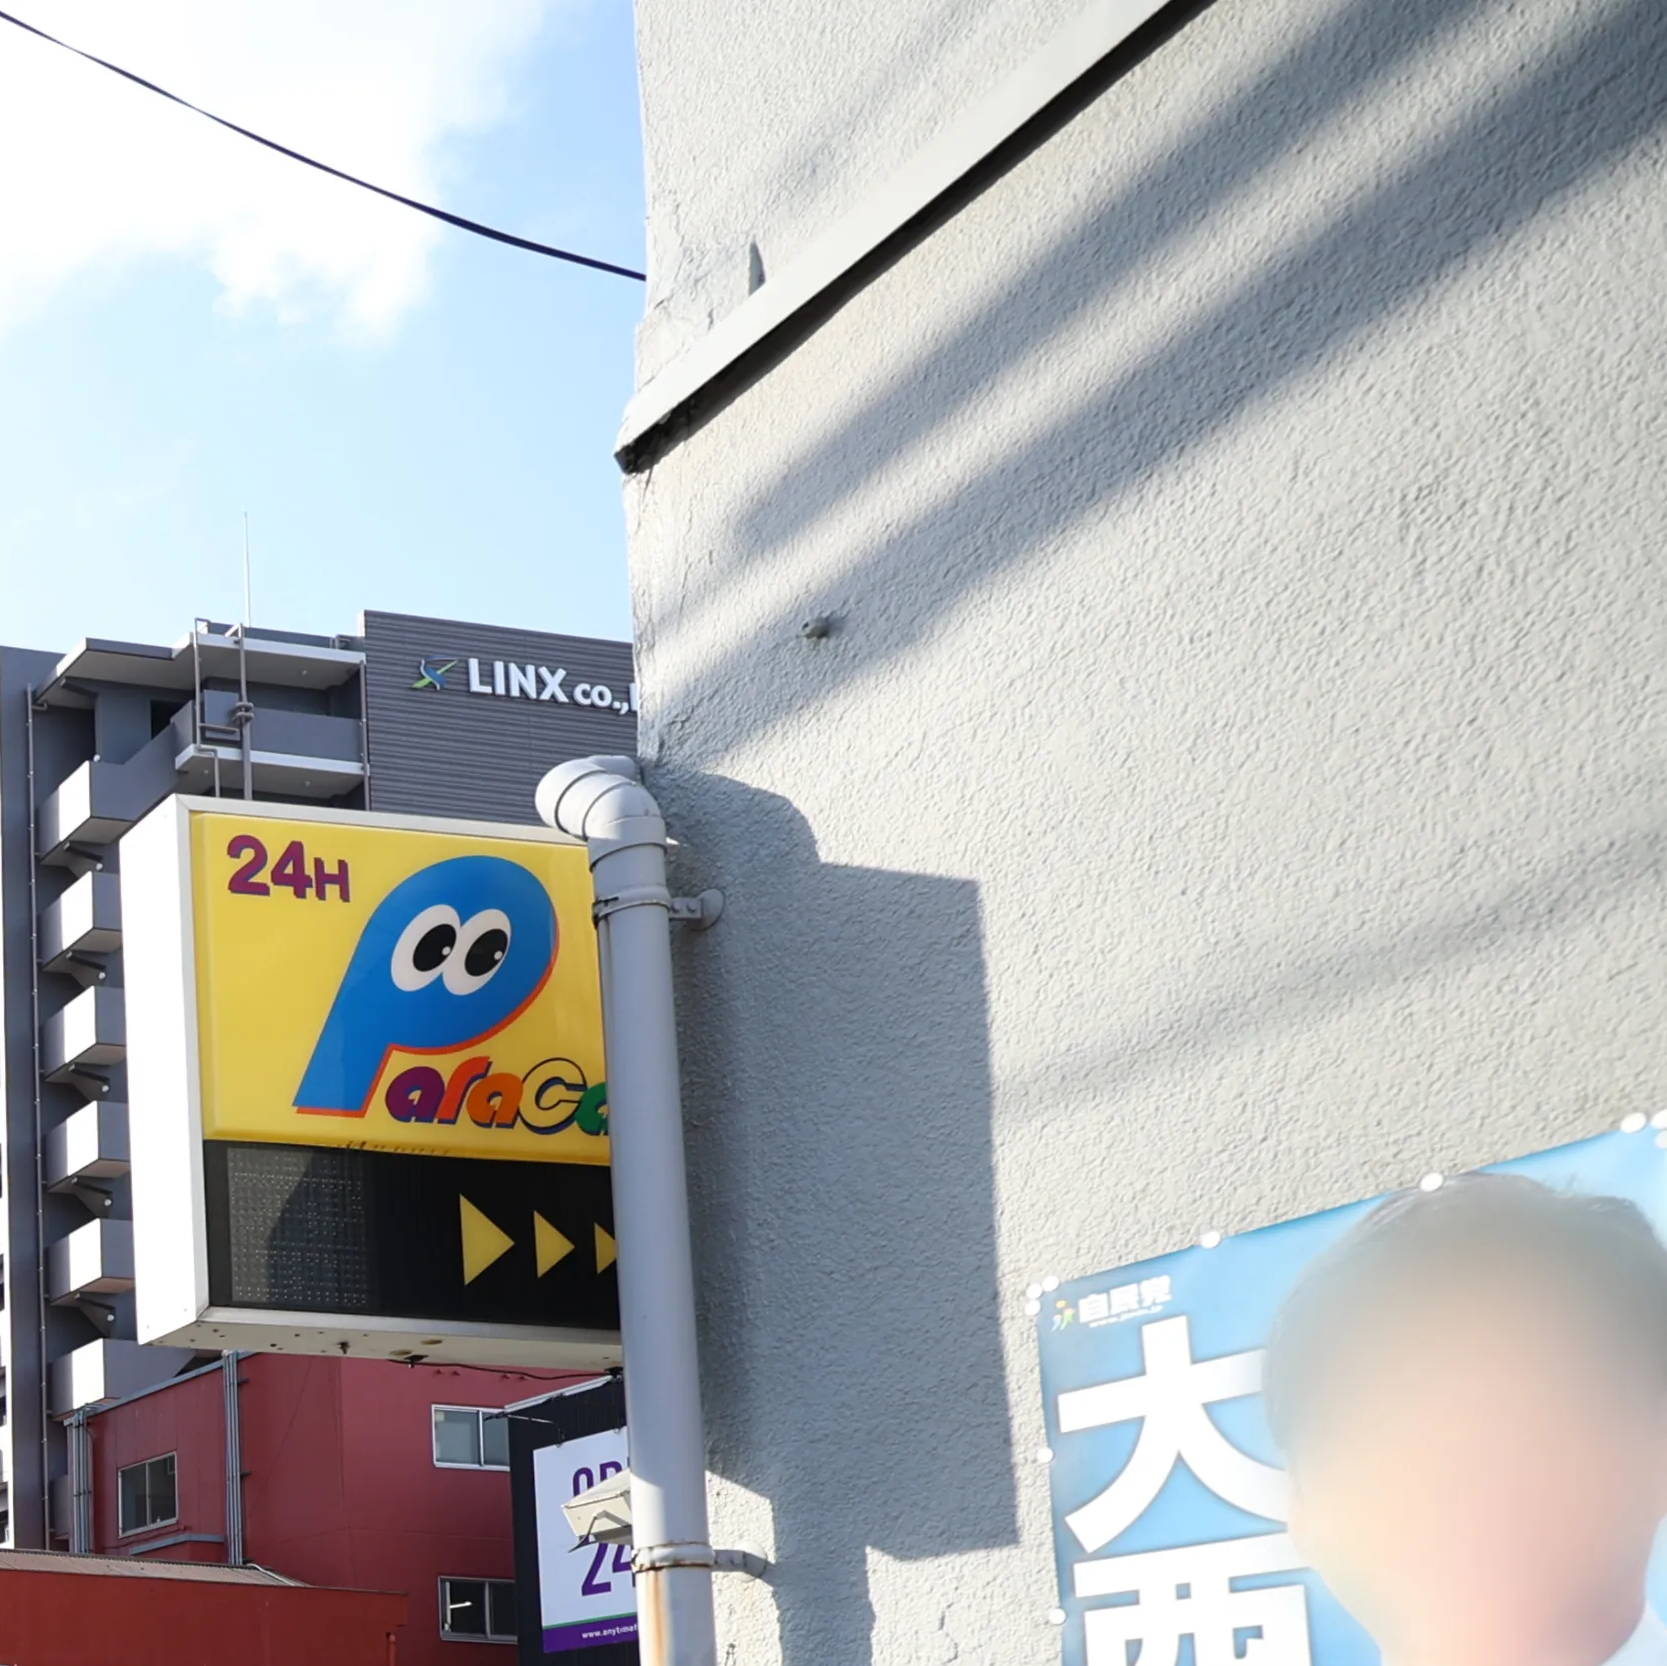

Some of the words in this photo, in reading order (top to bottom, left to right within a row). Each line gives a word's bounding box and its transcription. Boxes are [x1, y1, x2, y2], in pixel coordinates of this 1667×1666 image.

[468, 657, 569, 704] LINX
[227, 834, 351, 902] 24H
[1078, 1275, 1172, 1323] 自民党
